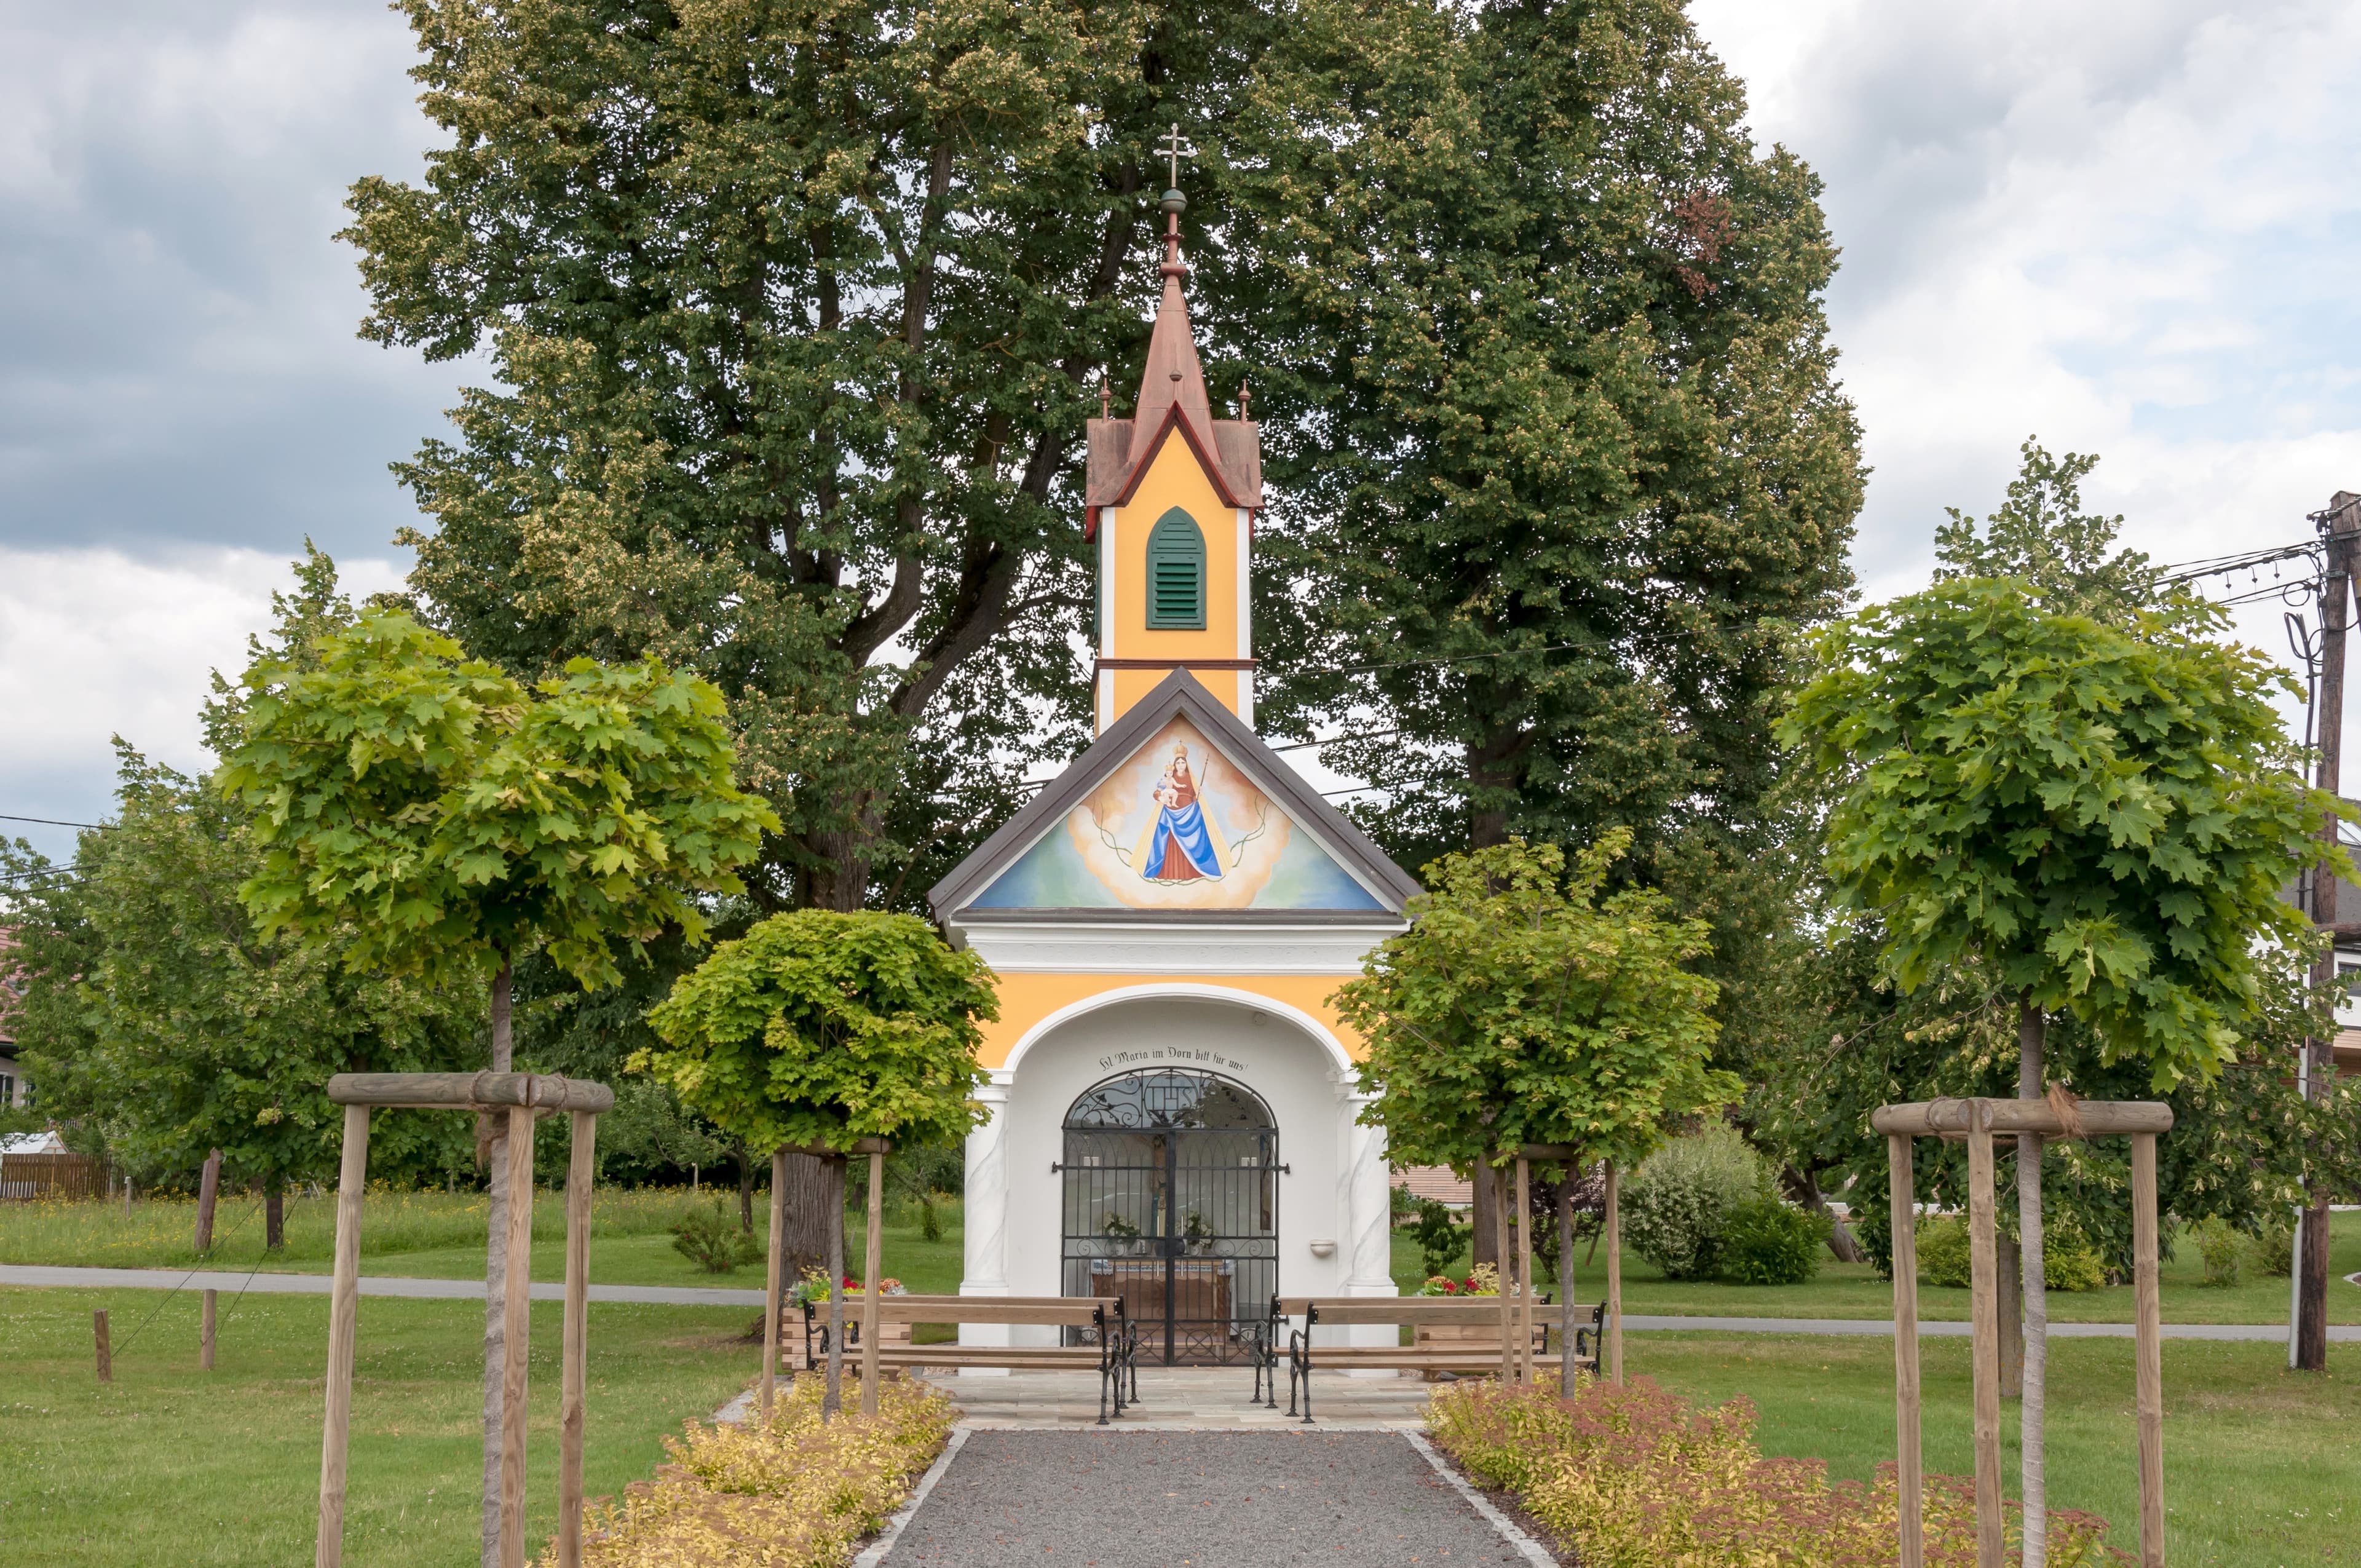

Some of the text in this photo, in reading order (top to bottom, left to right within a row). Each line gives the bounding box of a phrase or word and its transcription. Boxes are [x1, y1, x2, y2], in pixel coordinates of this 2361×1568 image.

[1115, 1051, 1148, 1064] Maria
[1152, 1048, 1163, 1058] im
[1168, 1046, 1191, 1059] Dorn
[1228, 1059, 1248, 1072] uns!
